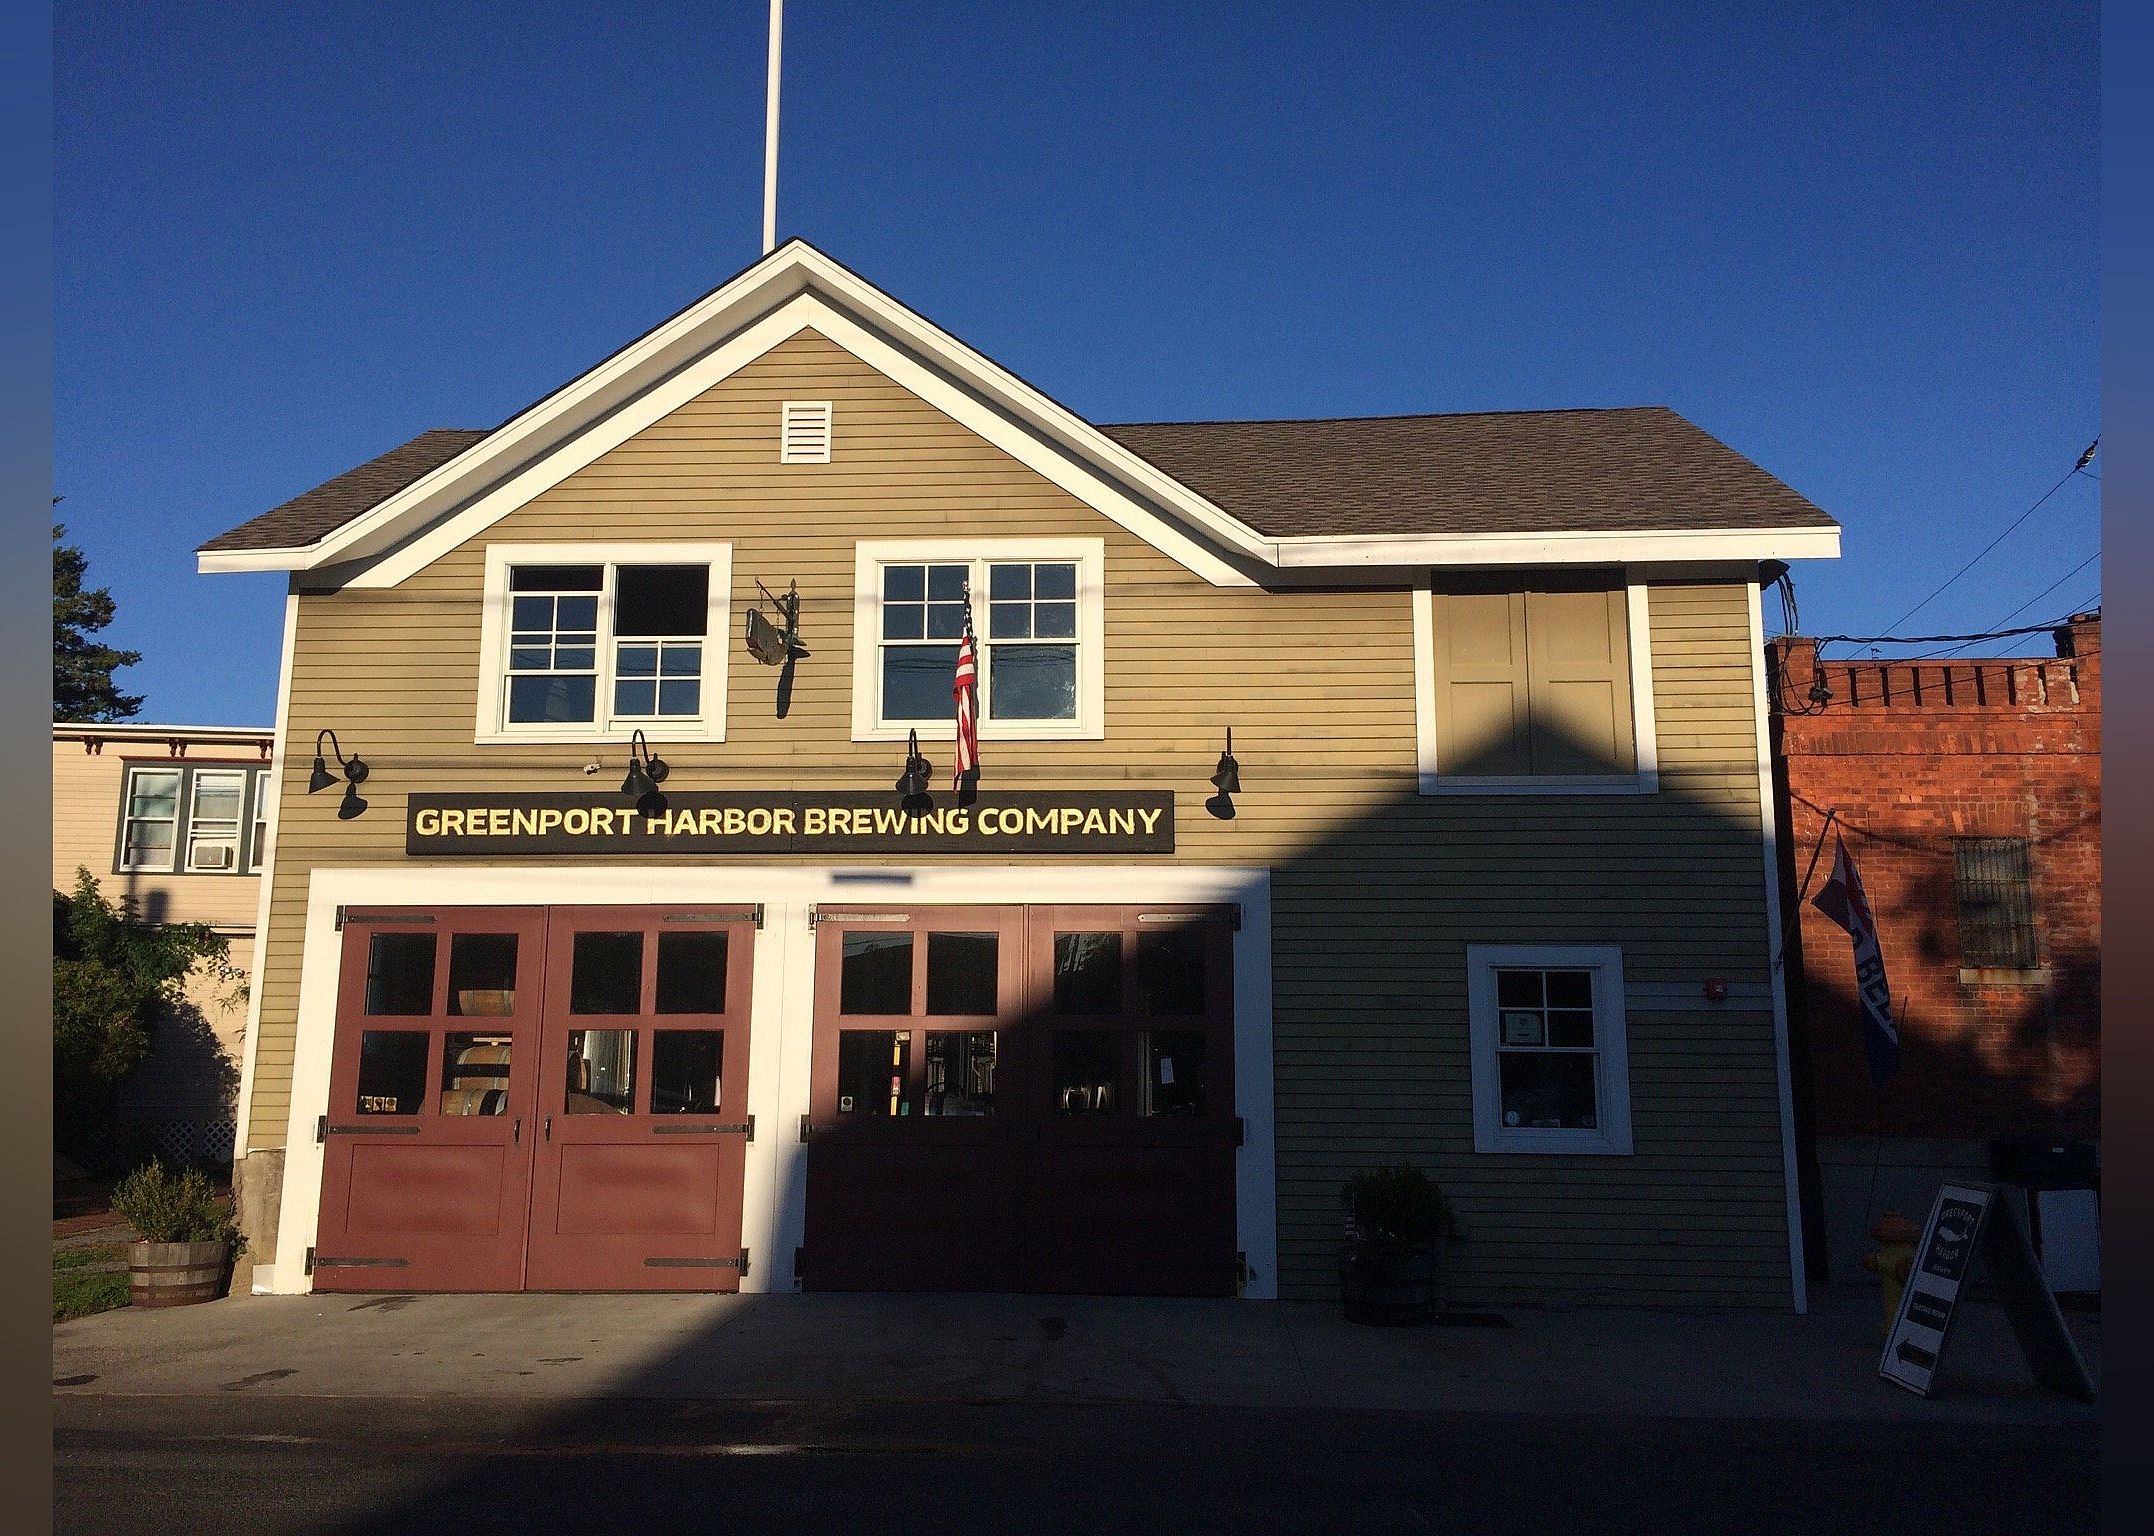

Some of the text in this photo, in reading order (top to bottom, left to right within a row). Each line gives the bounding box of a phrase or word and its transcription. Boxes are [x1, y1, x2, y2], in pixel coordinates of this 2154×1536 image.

[415, 807, 1163, 836] GREENPORT HARBOR BREWING COMPANY
